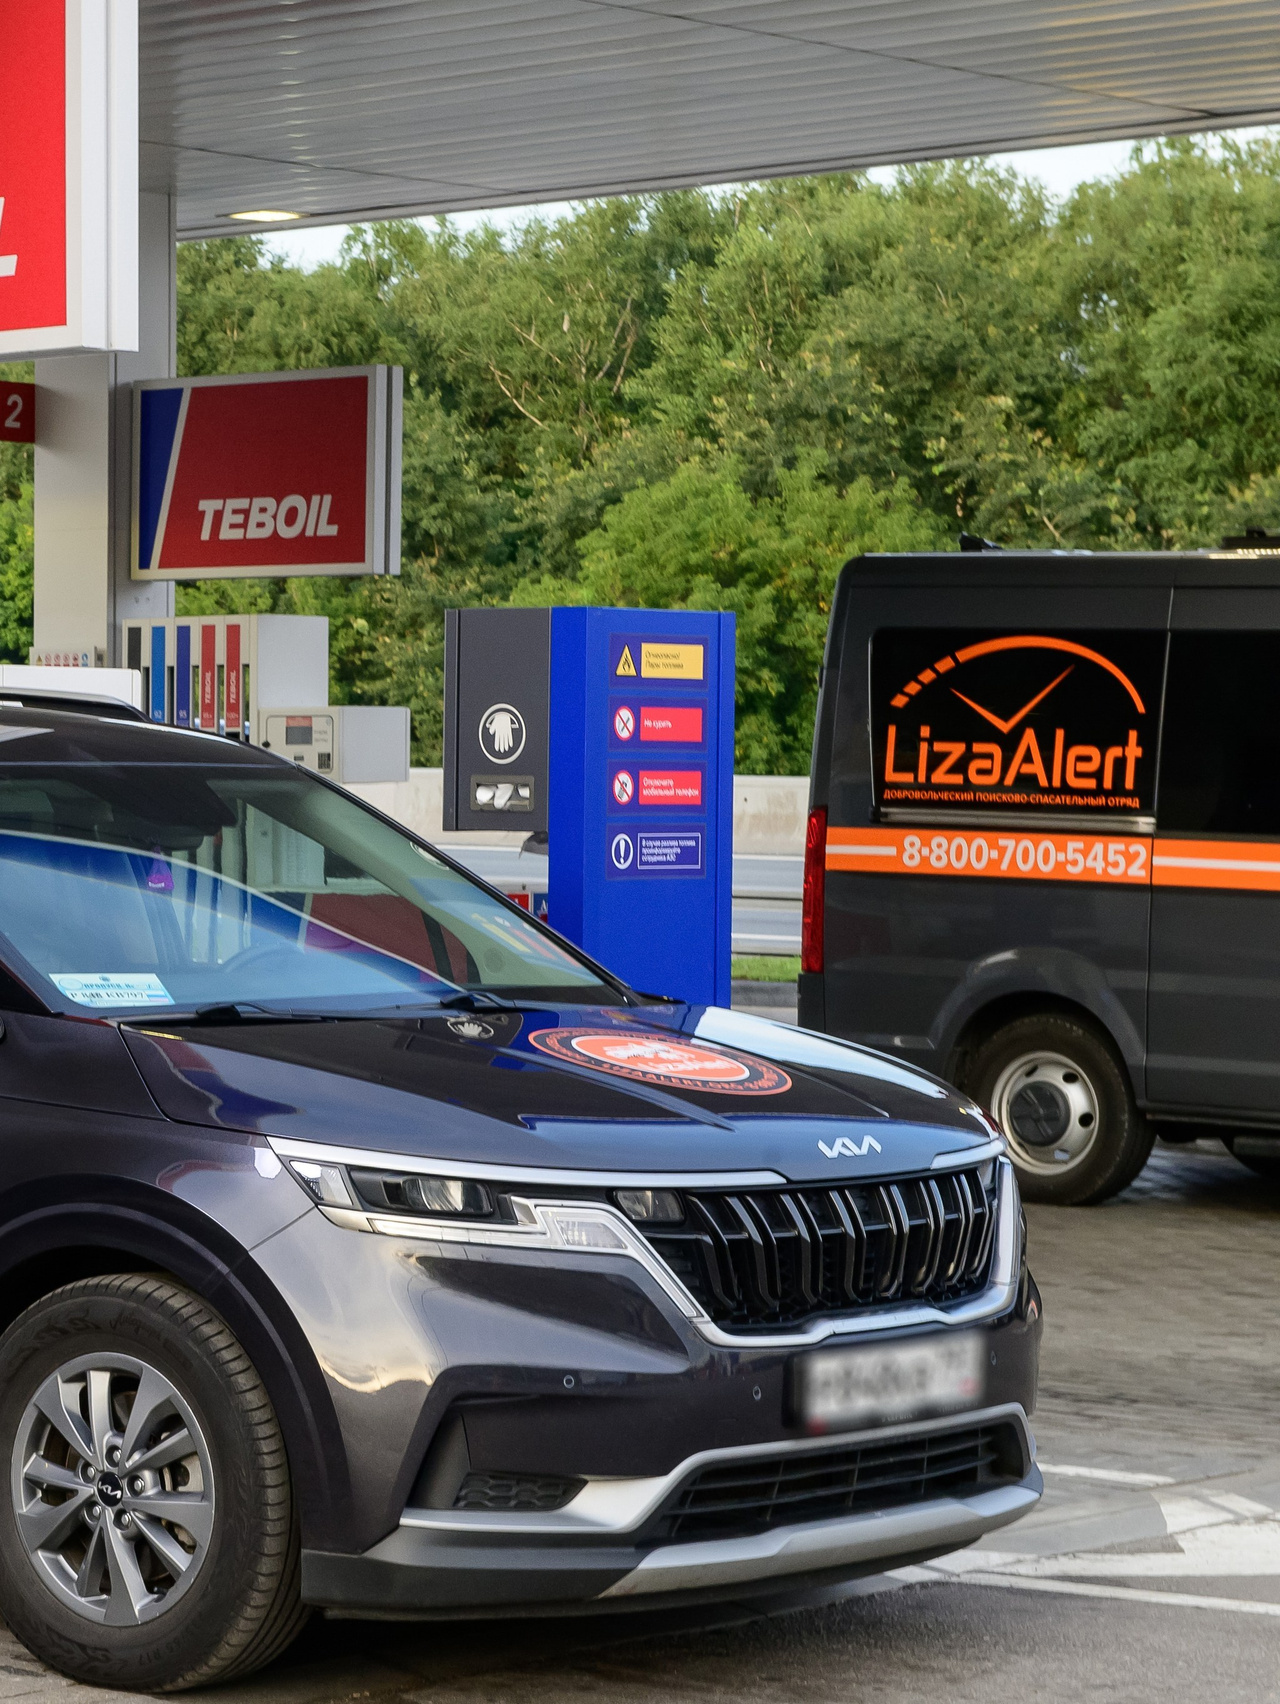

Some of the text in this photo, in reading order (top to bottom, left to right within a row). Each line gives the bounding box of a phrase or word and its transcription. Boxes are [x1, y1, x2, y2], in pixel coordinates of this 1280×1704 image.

[4, 393, 23, 428] 2
[198, 494, 339, 541] TEBOIL
[885, 724, 1142, 790] LizaAlert
[883, 788, 1140, 809] ДОБРОВОЛЬЧЕСКИЙ ПОИСКОВО-СПАСАТЕЛЬНЫЙ ОТРЯД
[902, 834, 1147, 877] 8-800-700-5452
